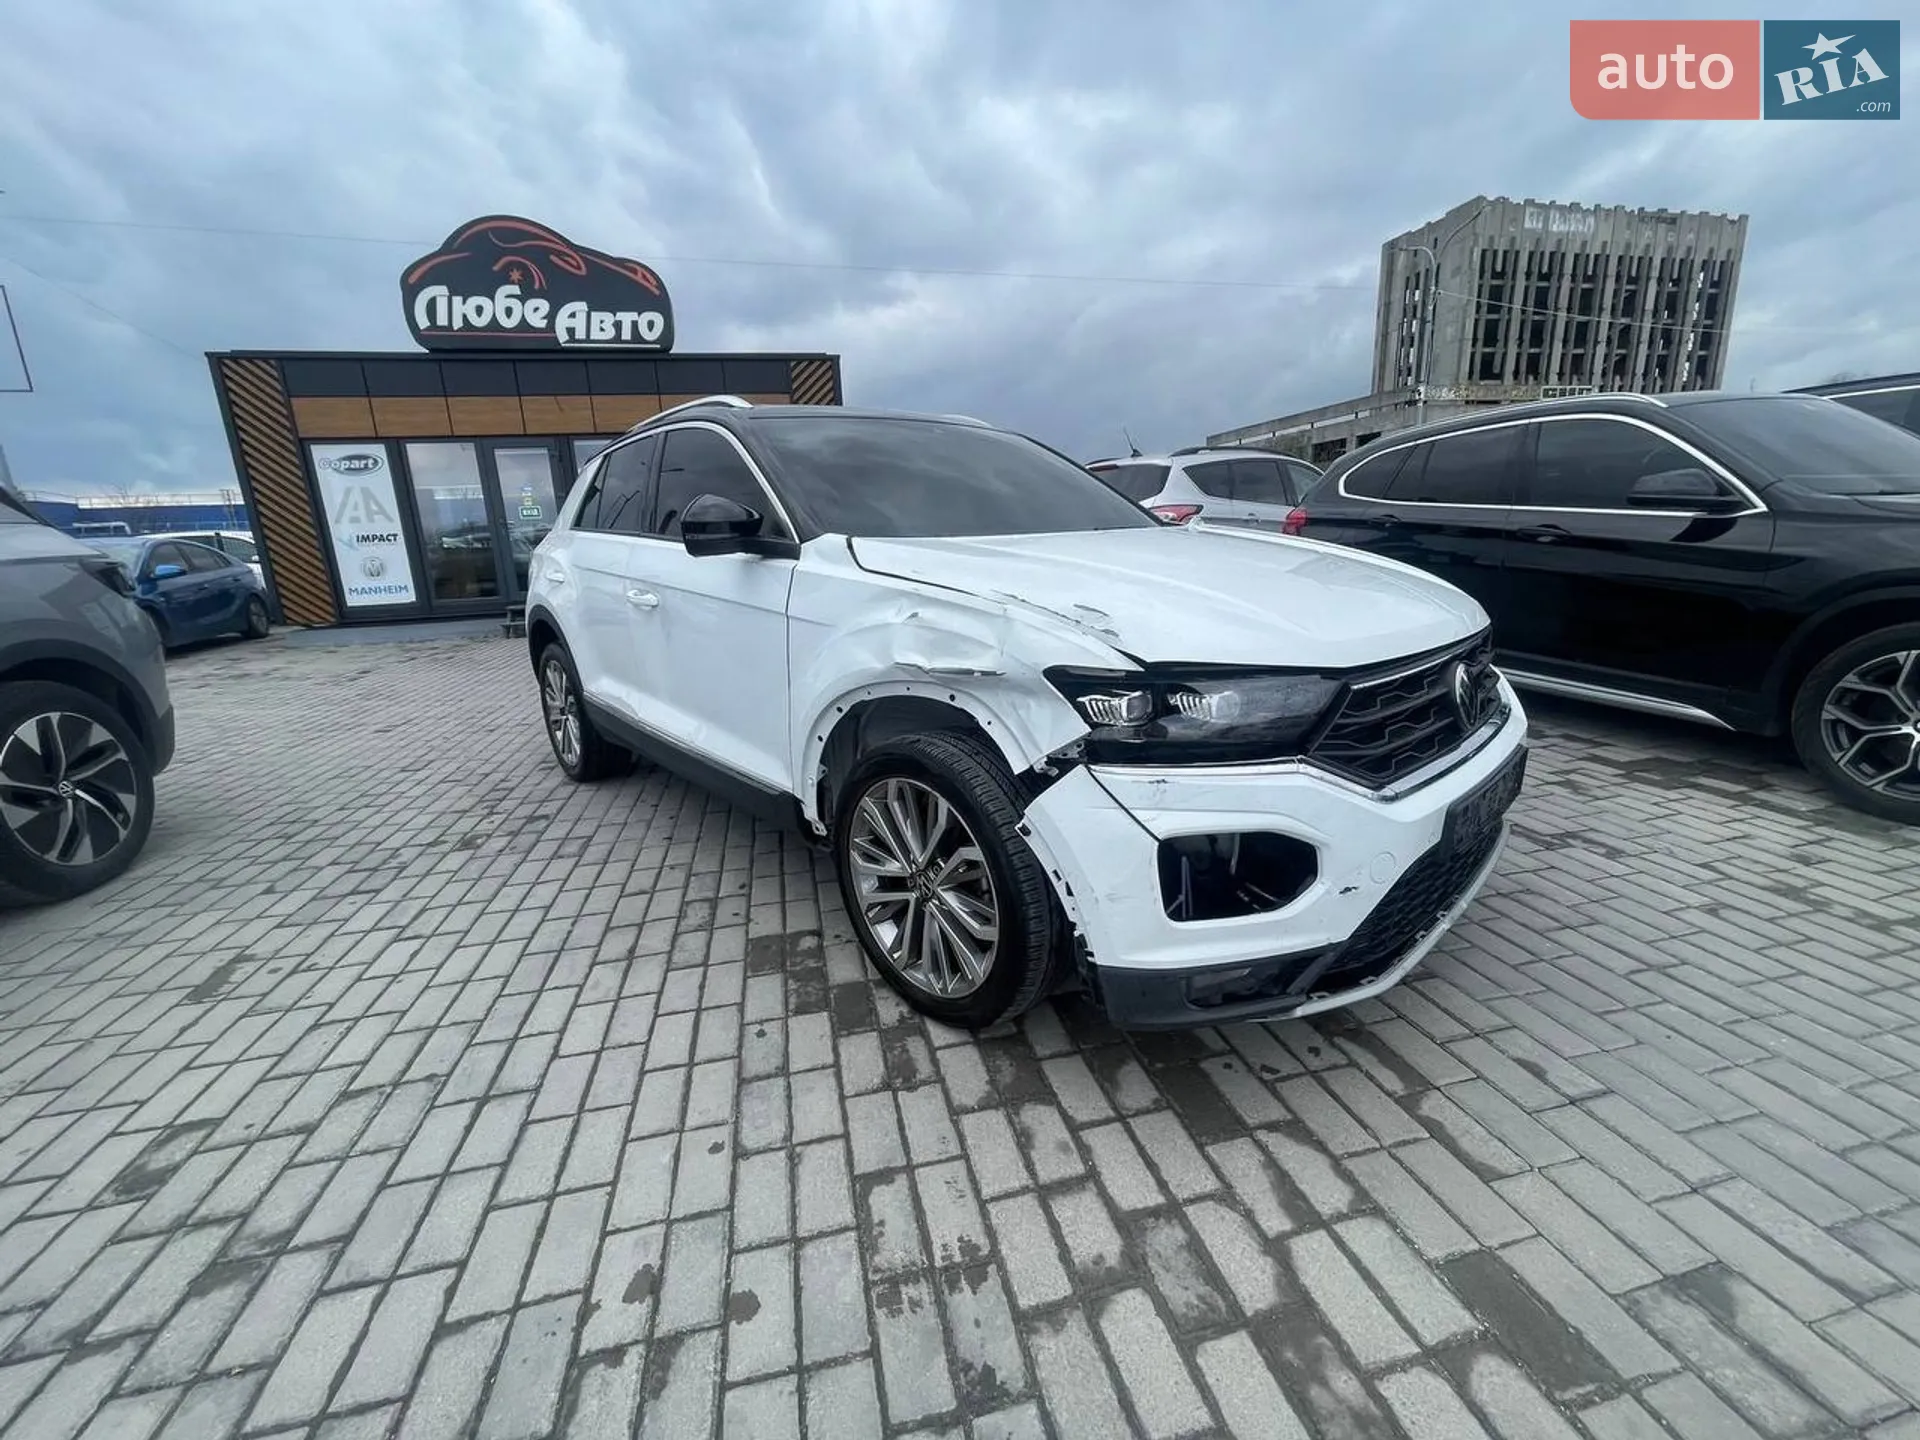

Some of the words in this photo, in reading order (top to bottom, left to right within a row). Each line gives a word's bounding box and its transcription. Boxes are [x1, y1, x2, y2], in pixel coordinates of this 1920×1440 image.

[413, 284, 551, 331] Любе
[554, 301, 665, 344] Авто
[356, 533, 399, 544] IMPACT
[348, 584, 409, 597] MANHEIM
